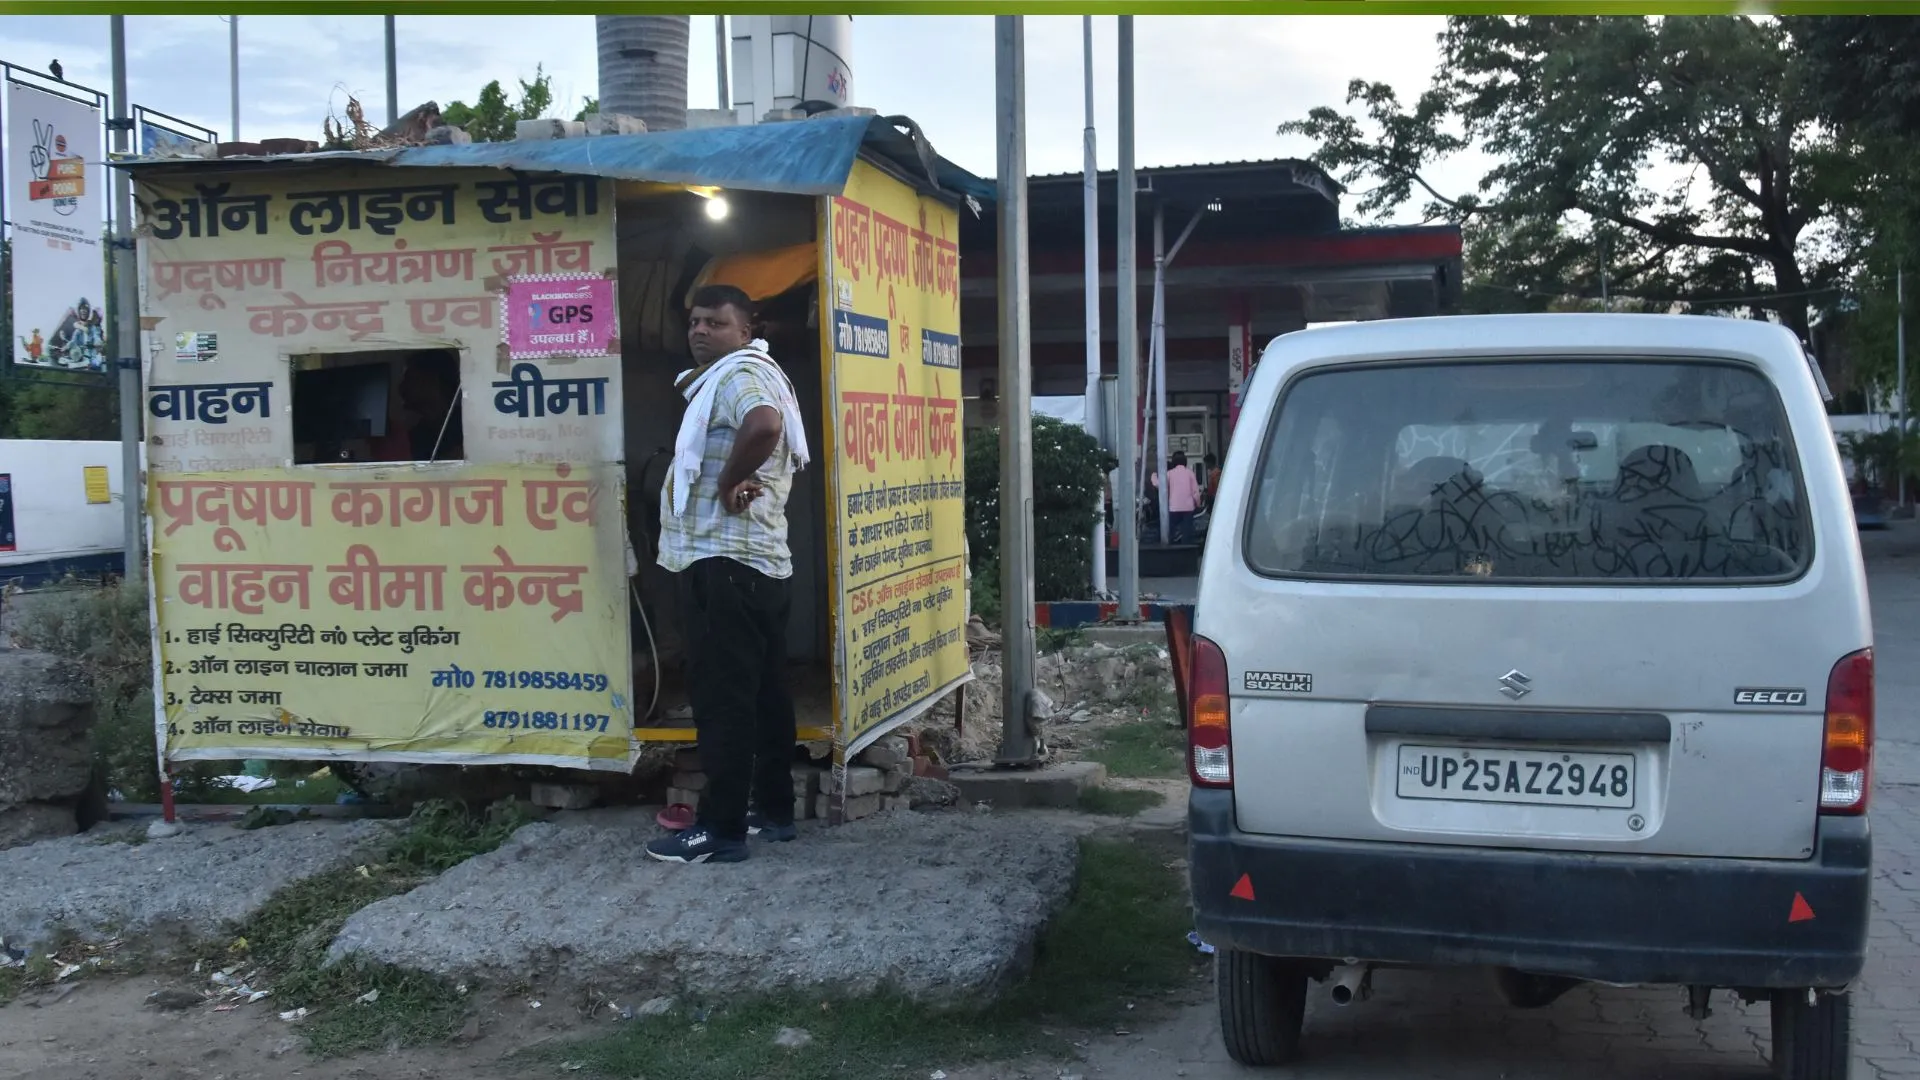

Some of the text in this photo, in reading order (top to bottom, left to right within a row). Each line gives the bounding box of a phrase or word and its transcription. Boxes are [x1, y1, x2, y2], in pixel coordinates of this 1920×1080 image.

[151, 181, 271, 239] ऑन
[286, 180, 460, 236] लाइन
[476, 172, 599, 223] सेवा
[834, 195, 871, 282] वाहन
[873, 209, 910, 320] प्रदूषण
[153, 256, 286, 309] प्रदूषण
[312, 238, 477, 288] नियंत्रण
[246, 291, 389, 341] केन्द्र
[548, 304, 594, 324] GPS
[149, 362, 609, 425] वाहन बीमा
[842, 363, 957, 474] वाहन बीमा केन्द्र
[156, 478, 317, 552] प्रदूषण
[329, 479, 507, 528] कागज
[175, 543, 588, 624] वाहन बीमा केन्द्र
[851, 588, 874, 616] CSC
[164, 629, 181, 645] 1.
[186, 623, 221, 645] हाई
[353, 625, 394, 647] प्लेट
[398, 625, 461, 653] बुकिंग
[188, 655, 229, 675] ऑन
[234, 658, 289, 677] लाइन
[295, 659, 358, 678] चालान
[363, 662, 409, 679] जमा
[481, 669, 608, 692] 7819858459
[1246, 671, 1312, 683] MARUTI
[188, 685, 233, 706] टेक्स
[238, 690, 283, 706] जमा
[1246, 680, 1312, 692] SUZUKI
[1735, 691, 1805, 703] EECO
[191, 715, 232, 736] ऑन
[483, 710, 610, 733] 8791881197
[1402, 754, 1628, 798] IND UP25AZ2948
[687, 835, 707, 847] PUMA
